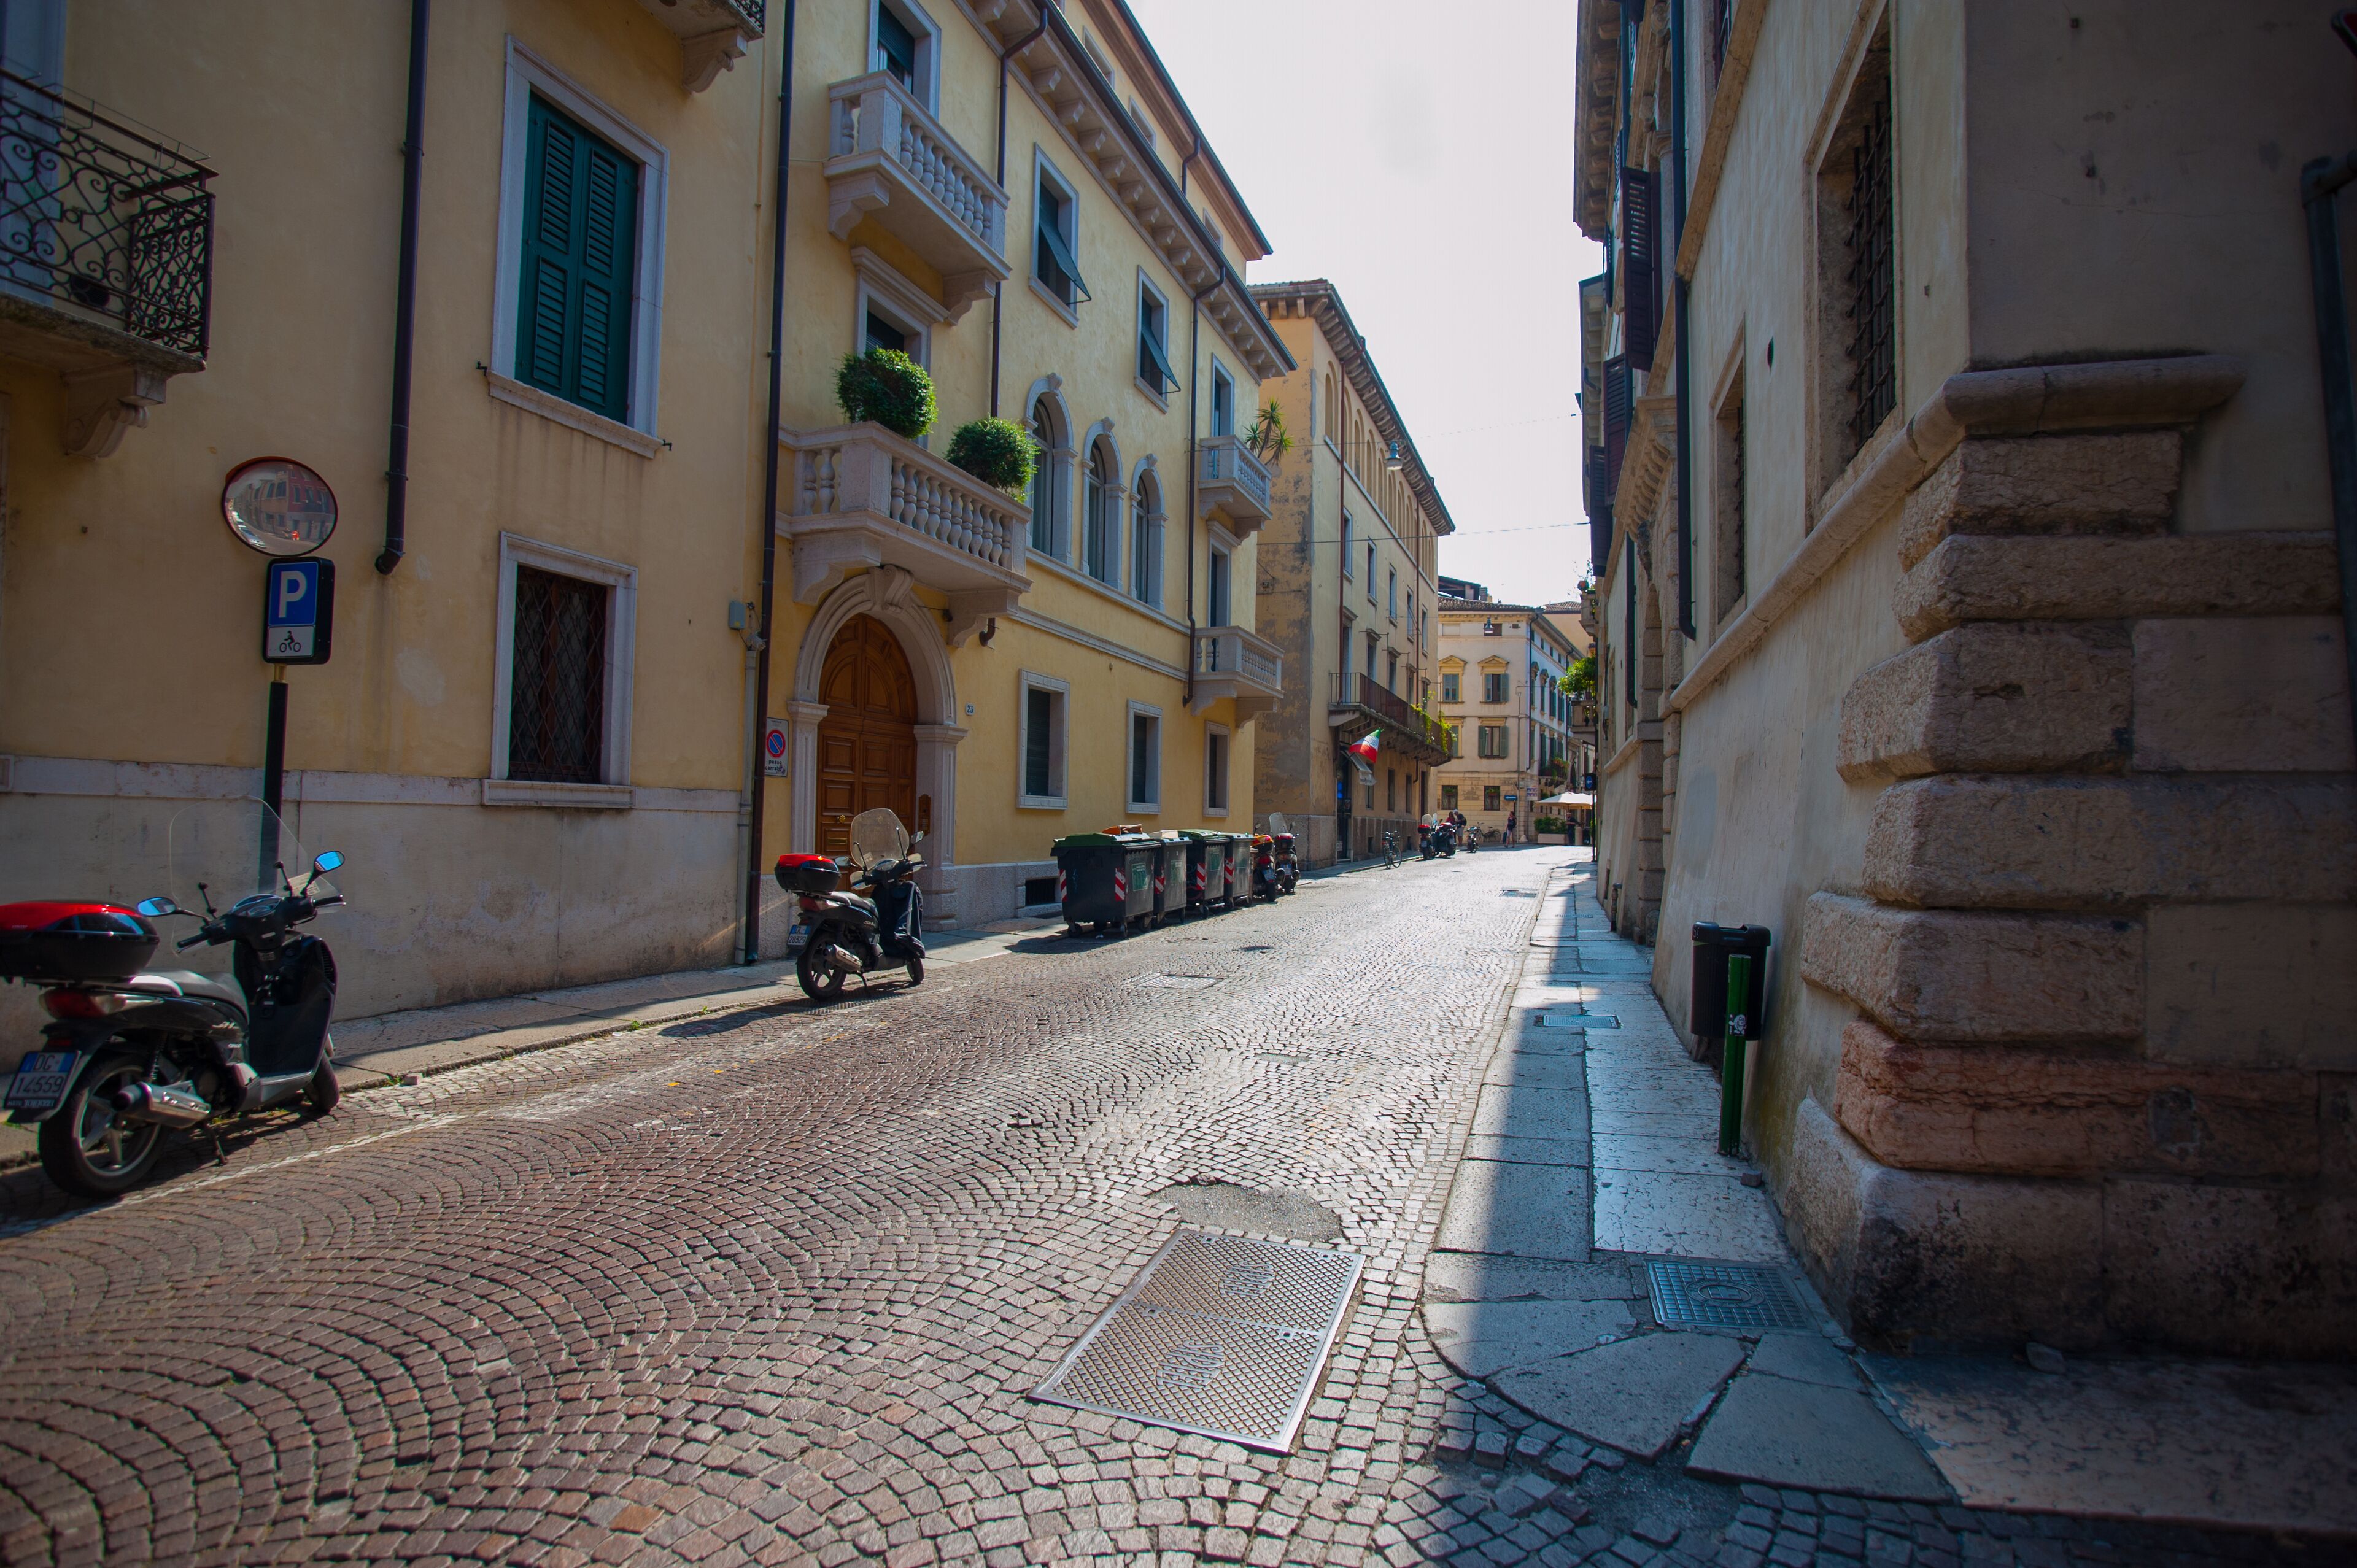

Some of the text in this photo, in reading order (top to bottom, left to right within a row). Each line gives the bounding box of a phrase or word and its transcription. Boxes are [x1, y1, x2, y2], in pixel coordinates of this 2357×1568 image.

[279, 571, 307, 617] P
[967, 705, 973, 713] 23
[34, 1055, 55, 1071] DG
[16, 1076, 64, 1094] 14559
[1155, 1340, 1225, 1389] SIPTEL
